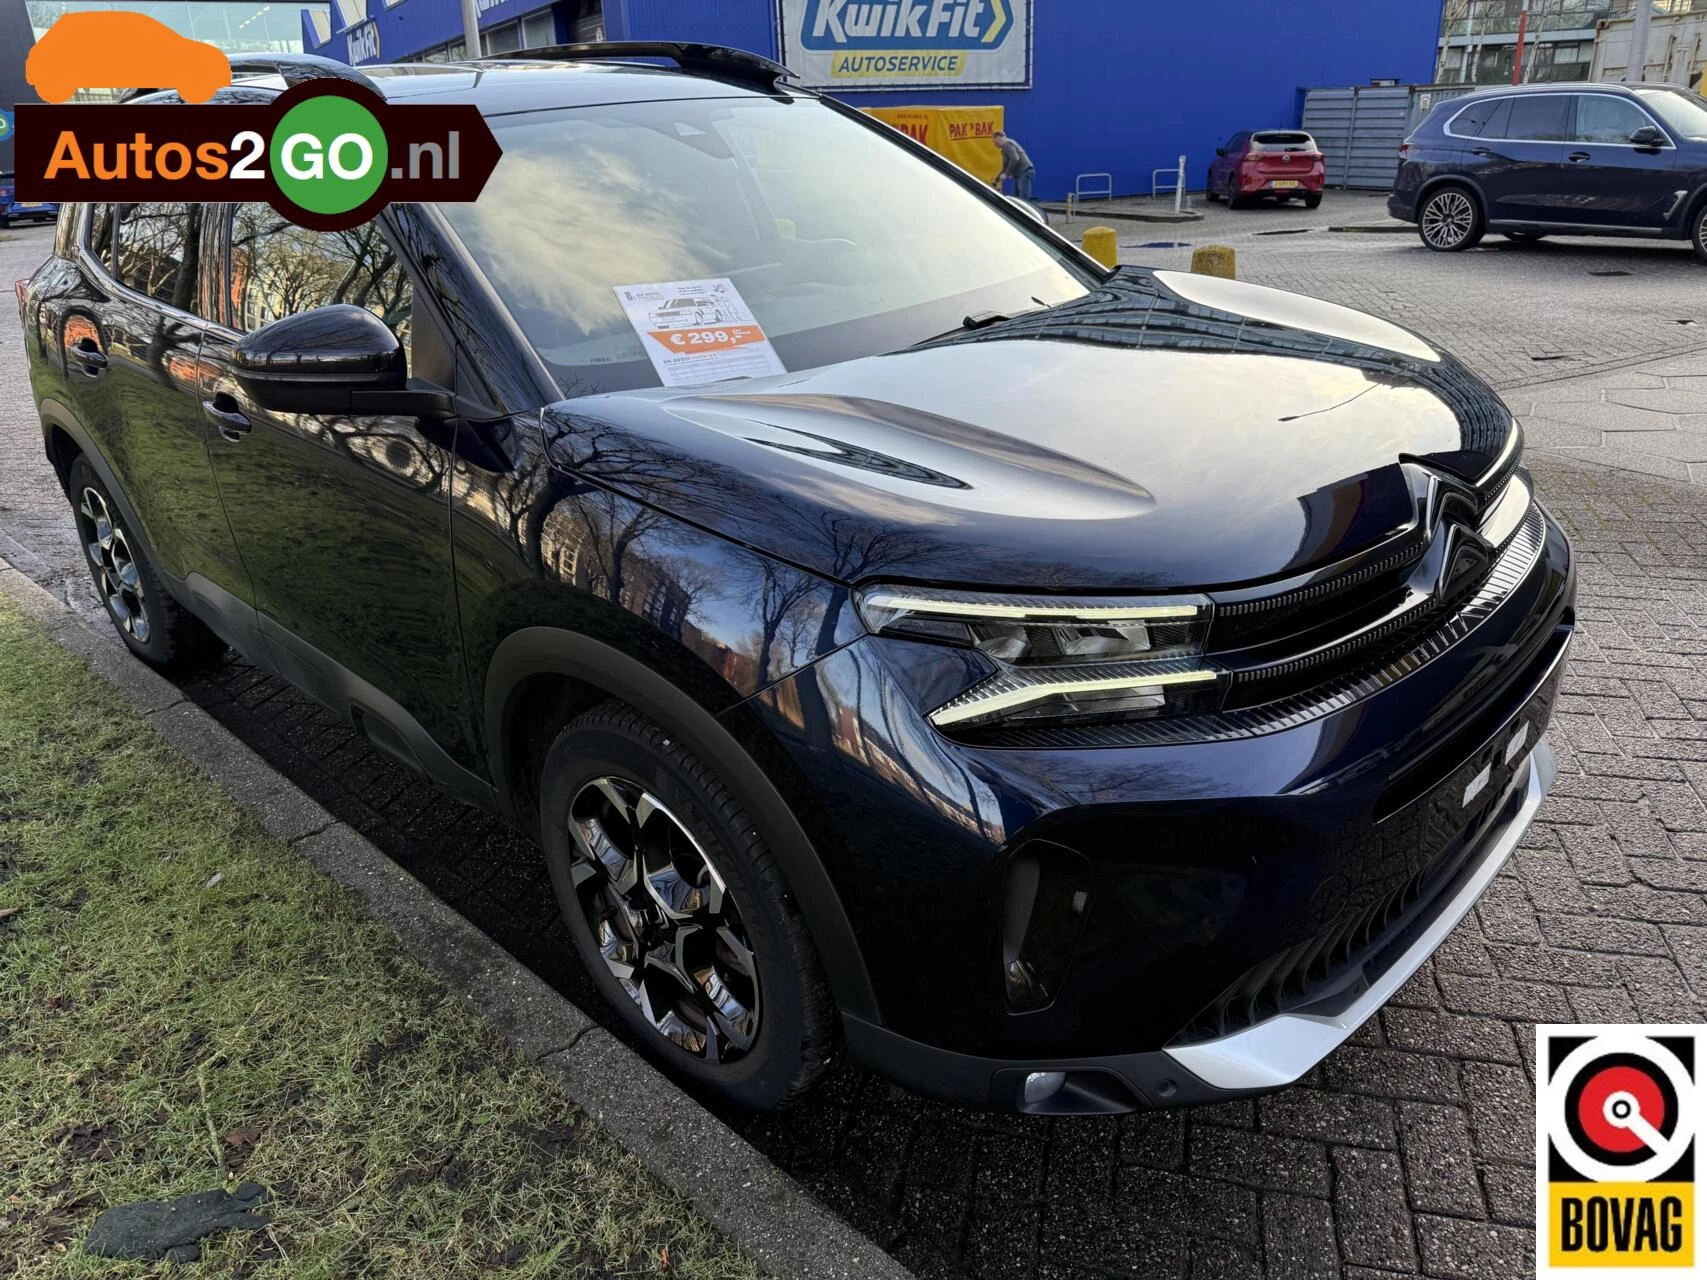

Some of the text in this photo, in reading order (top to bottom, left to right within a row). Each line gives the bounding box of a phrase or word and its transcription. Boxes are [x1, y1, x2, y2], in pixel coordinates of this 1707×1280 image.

[812, 0, 985, 43] KwikFit
[838, 55, 959, 73] AUTOSERVICE
[949, 123, 968, 138] PAK
[975, 121, 994, 136] BAK
[670, 333, 686, 345] €
